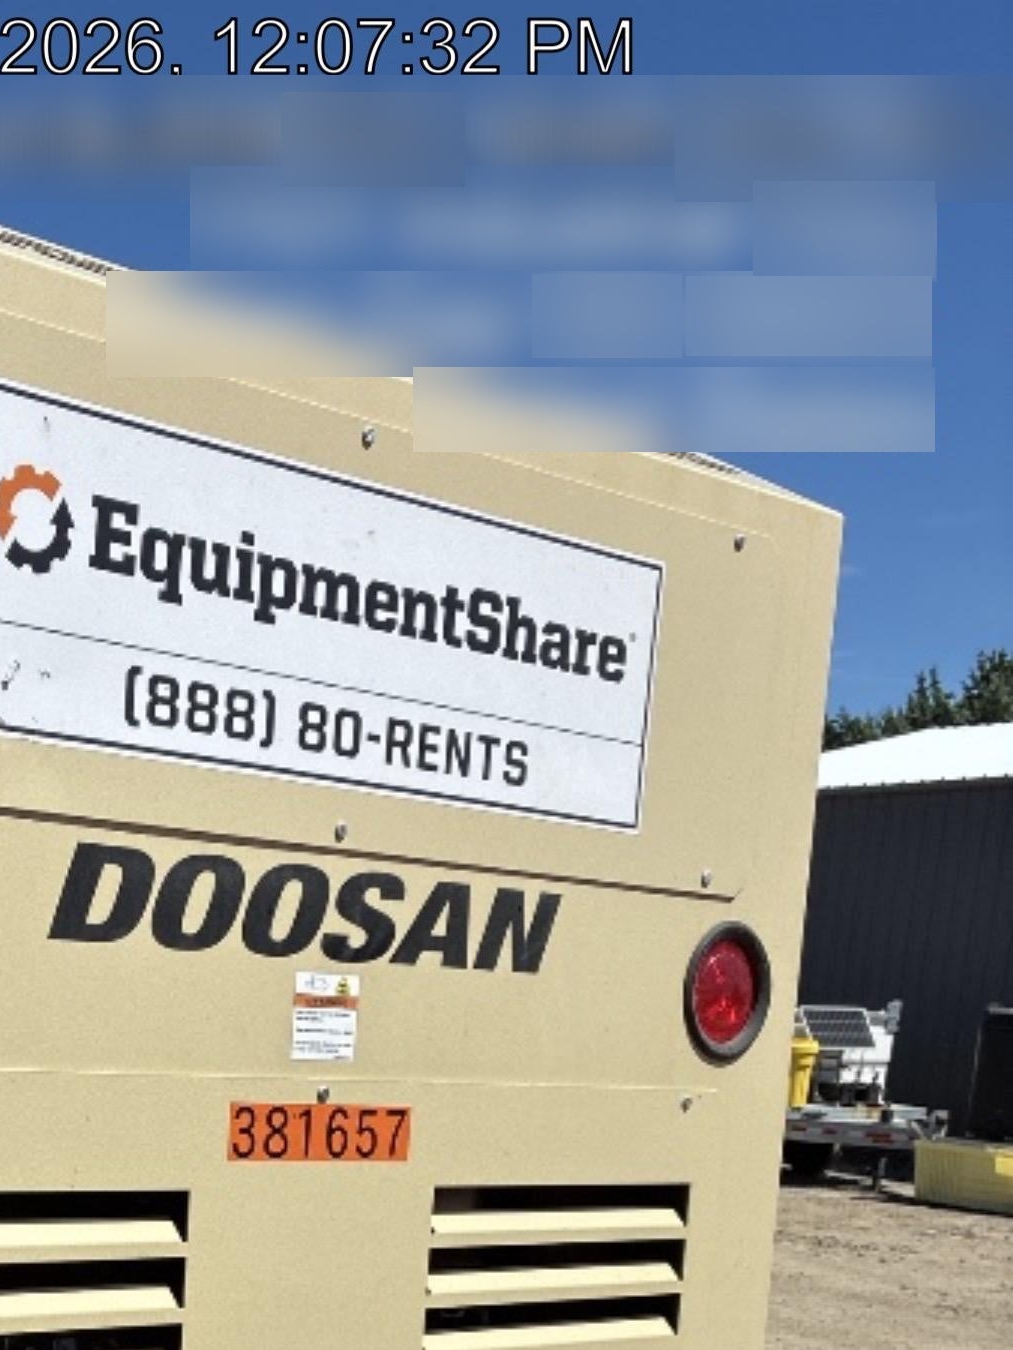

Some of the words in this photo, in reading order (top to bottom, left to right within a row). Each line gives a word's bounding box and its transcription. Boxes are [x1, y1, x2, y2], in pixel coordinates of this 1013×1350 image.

[88, 494, 628, 684] EquipmentShare
[123, 665, 277, 748] (888)
[297, 701, 529, 787] 80-RENTS
[46, 841, 563, 975] DOOSAN
[231, 1105, 410, 1160] 381657
